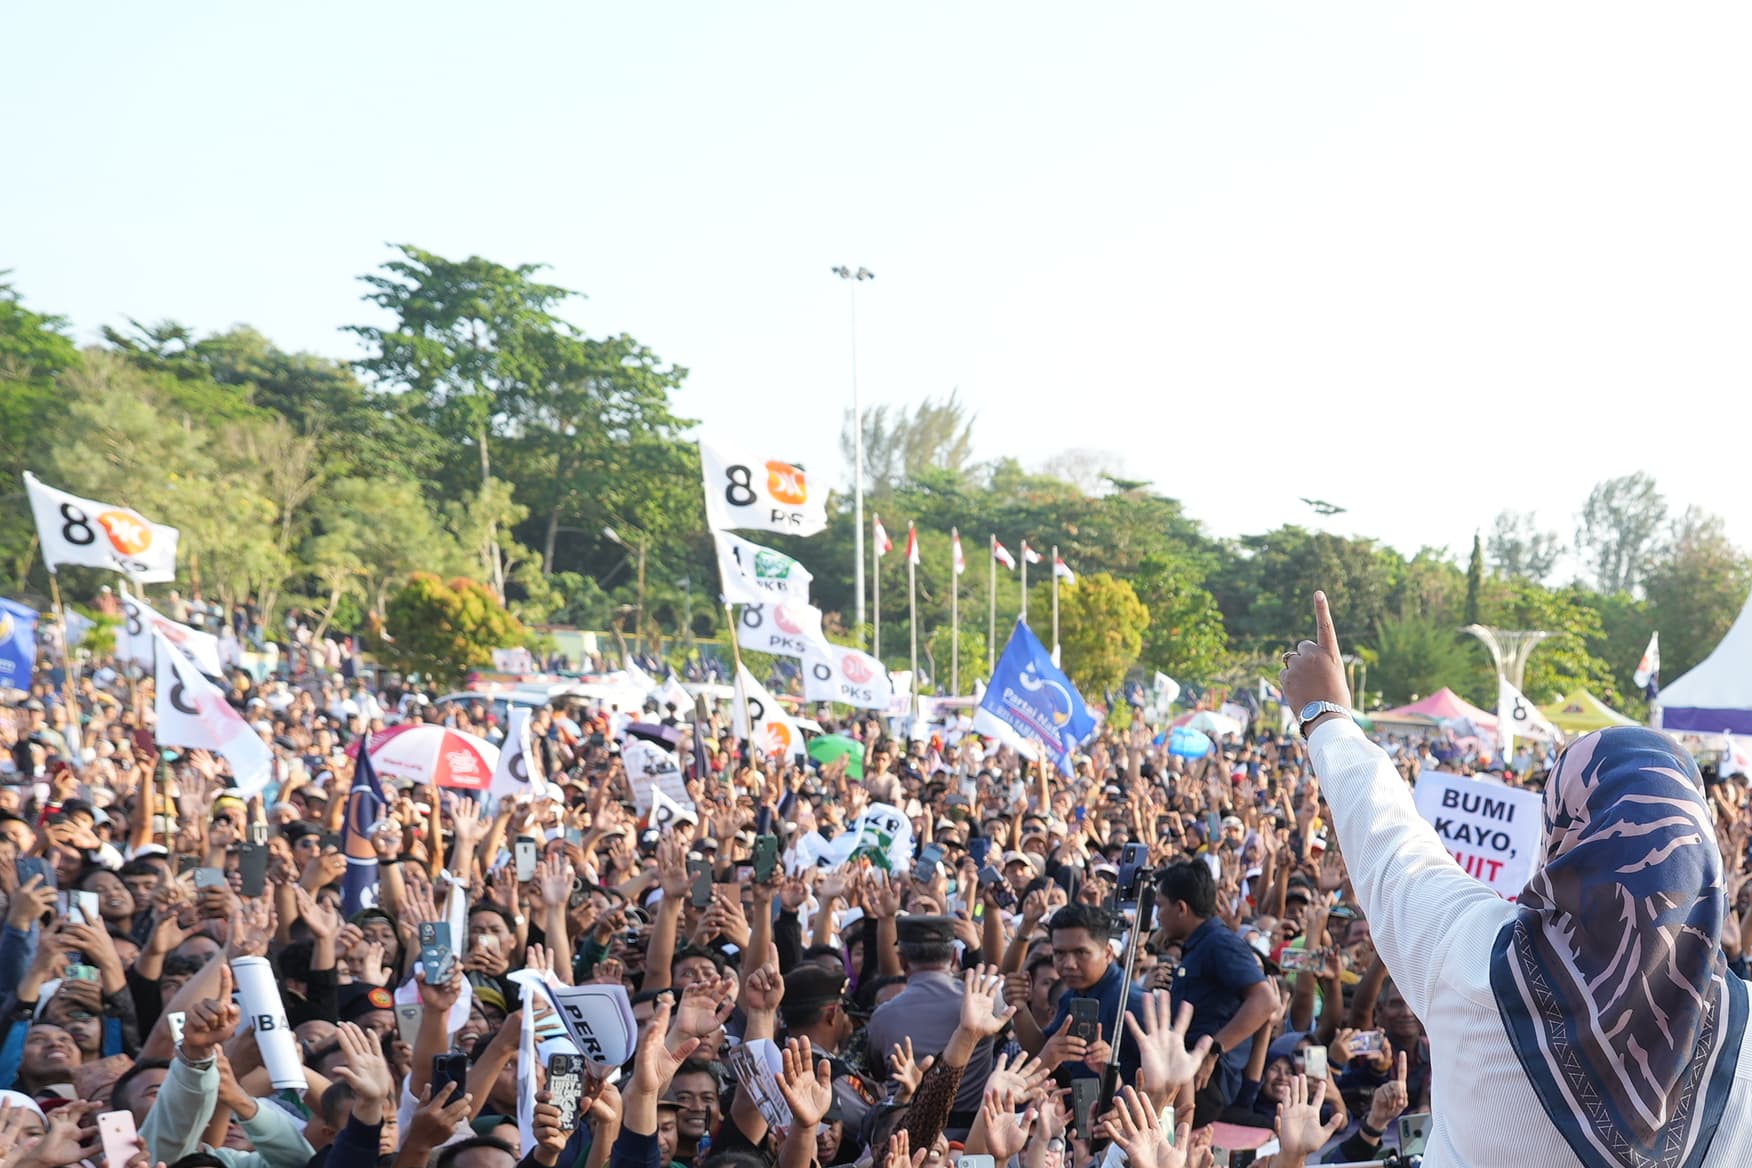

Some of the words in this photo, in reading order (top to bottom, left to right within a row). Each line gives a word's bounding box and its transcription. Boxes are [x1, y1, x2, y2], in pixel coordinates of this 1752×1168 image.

[725, 464, 757, 506] 8
[60, 503, 95, 545] 8
[769, 635, 806, 653] PKS
[840, 684, 872, 702] PKS
[1442, 788, 1516, 823] BUMI
[1434, 816, 1517, 860] KAYO,
